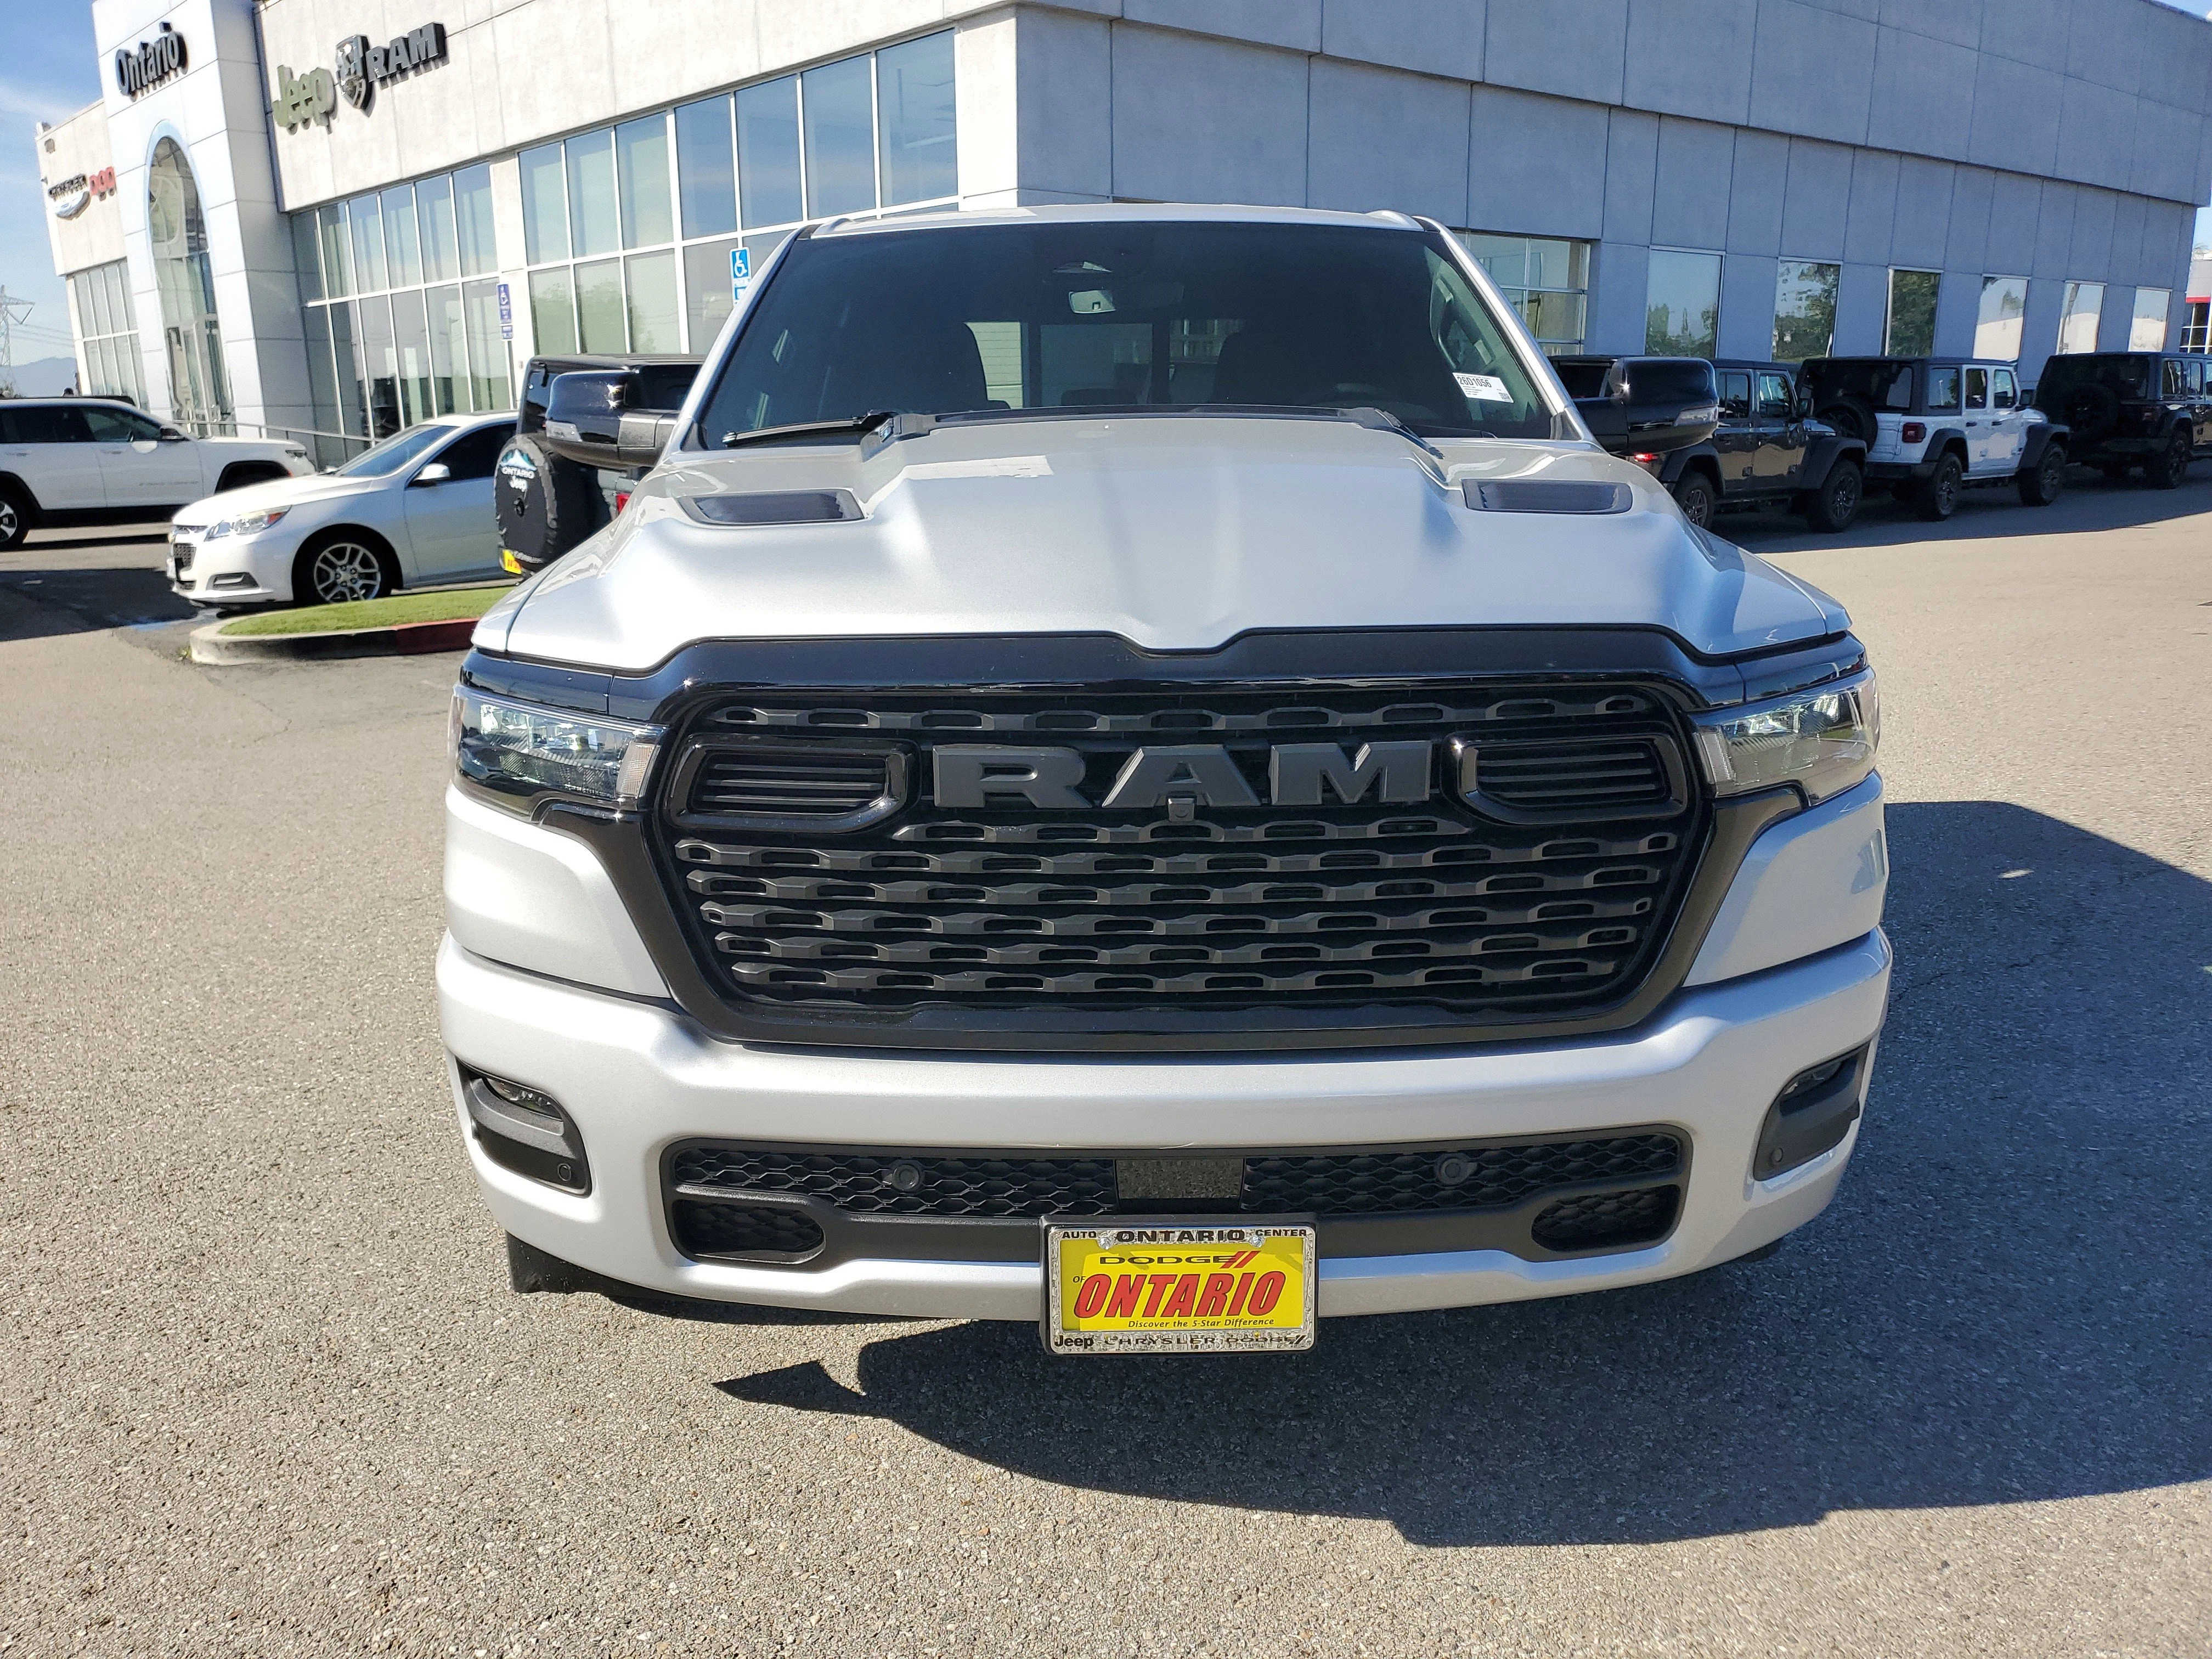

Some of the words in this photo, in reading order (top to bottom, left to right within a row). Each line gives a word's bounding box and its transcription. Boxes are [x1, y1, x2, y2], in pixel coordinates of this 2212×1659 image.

[115, 21, 188, 95] Ontario
[365, 21, 447, 82] RAM
[273, 64, 336, 127] Jeep
[501, 466, 535, 479] ONTARIO
[932, 741, 1432, 809] RAM
[1062, 1231, 1097, 1239] AUTO
[1116, 1230, 1245, 1242] ONTARIO
[1255, 1229, 1307, 1237] CENTER
[1099, 1255, 1237, 1265] DODGE
[1073, 1275, 1086, 1283] OF
[1074, 1271, 1286, 1318] ONTARIO
[1128, 1320, 1170, 1328] Discover
[1173, 1319, 1188, 1328] the
[1192, 1319, 1221, 1327] 5-Star
[1224, 1318, 1274, 1328] Difference
[1054, 1335, 1094, 1349] Jeep
[1104, 1336, 1216, 1345] CHRYSLER
